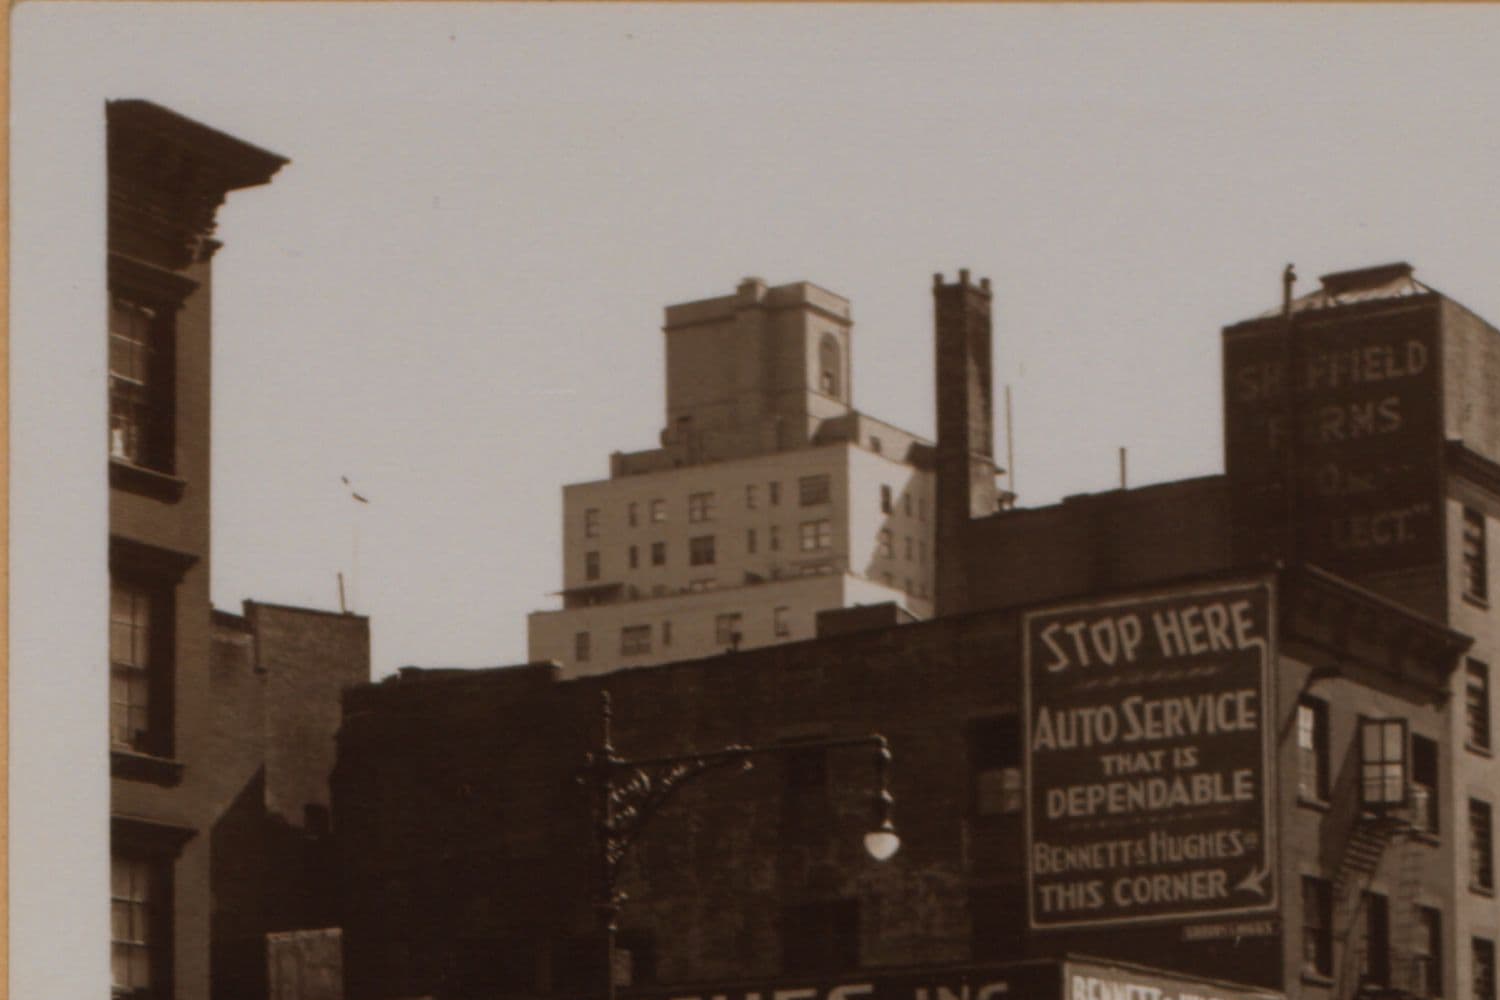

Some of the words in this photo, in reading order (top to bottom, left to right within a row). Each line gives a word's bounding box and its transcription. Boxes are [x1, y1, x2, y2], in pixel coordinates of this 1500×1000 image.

[1236, 339, 1428, 402] SHFFIELD
[1268, 396, 1403, 449] FRMS
[1040, 614, 1143, 674] STOP
[1153, 599, 1256, 658] HERE
[1033, 705, 1118, 752] AUTO
[1121, 690, 1257, 743] SERVICE
[1100, 750, 1166, 777] THAT
[1173, 746, 1200, 770] IS
[1047, 769, 1254, 819] DEPENDABLE
[1033, 839, 1136, 875] BENNETT
[1150, 829, 1244, 865] HUGHES
[1039, 880, 1105, 913] THIS
[1112, 868, 1229, 908] CORNER
